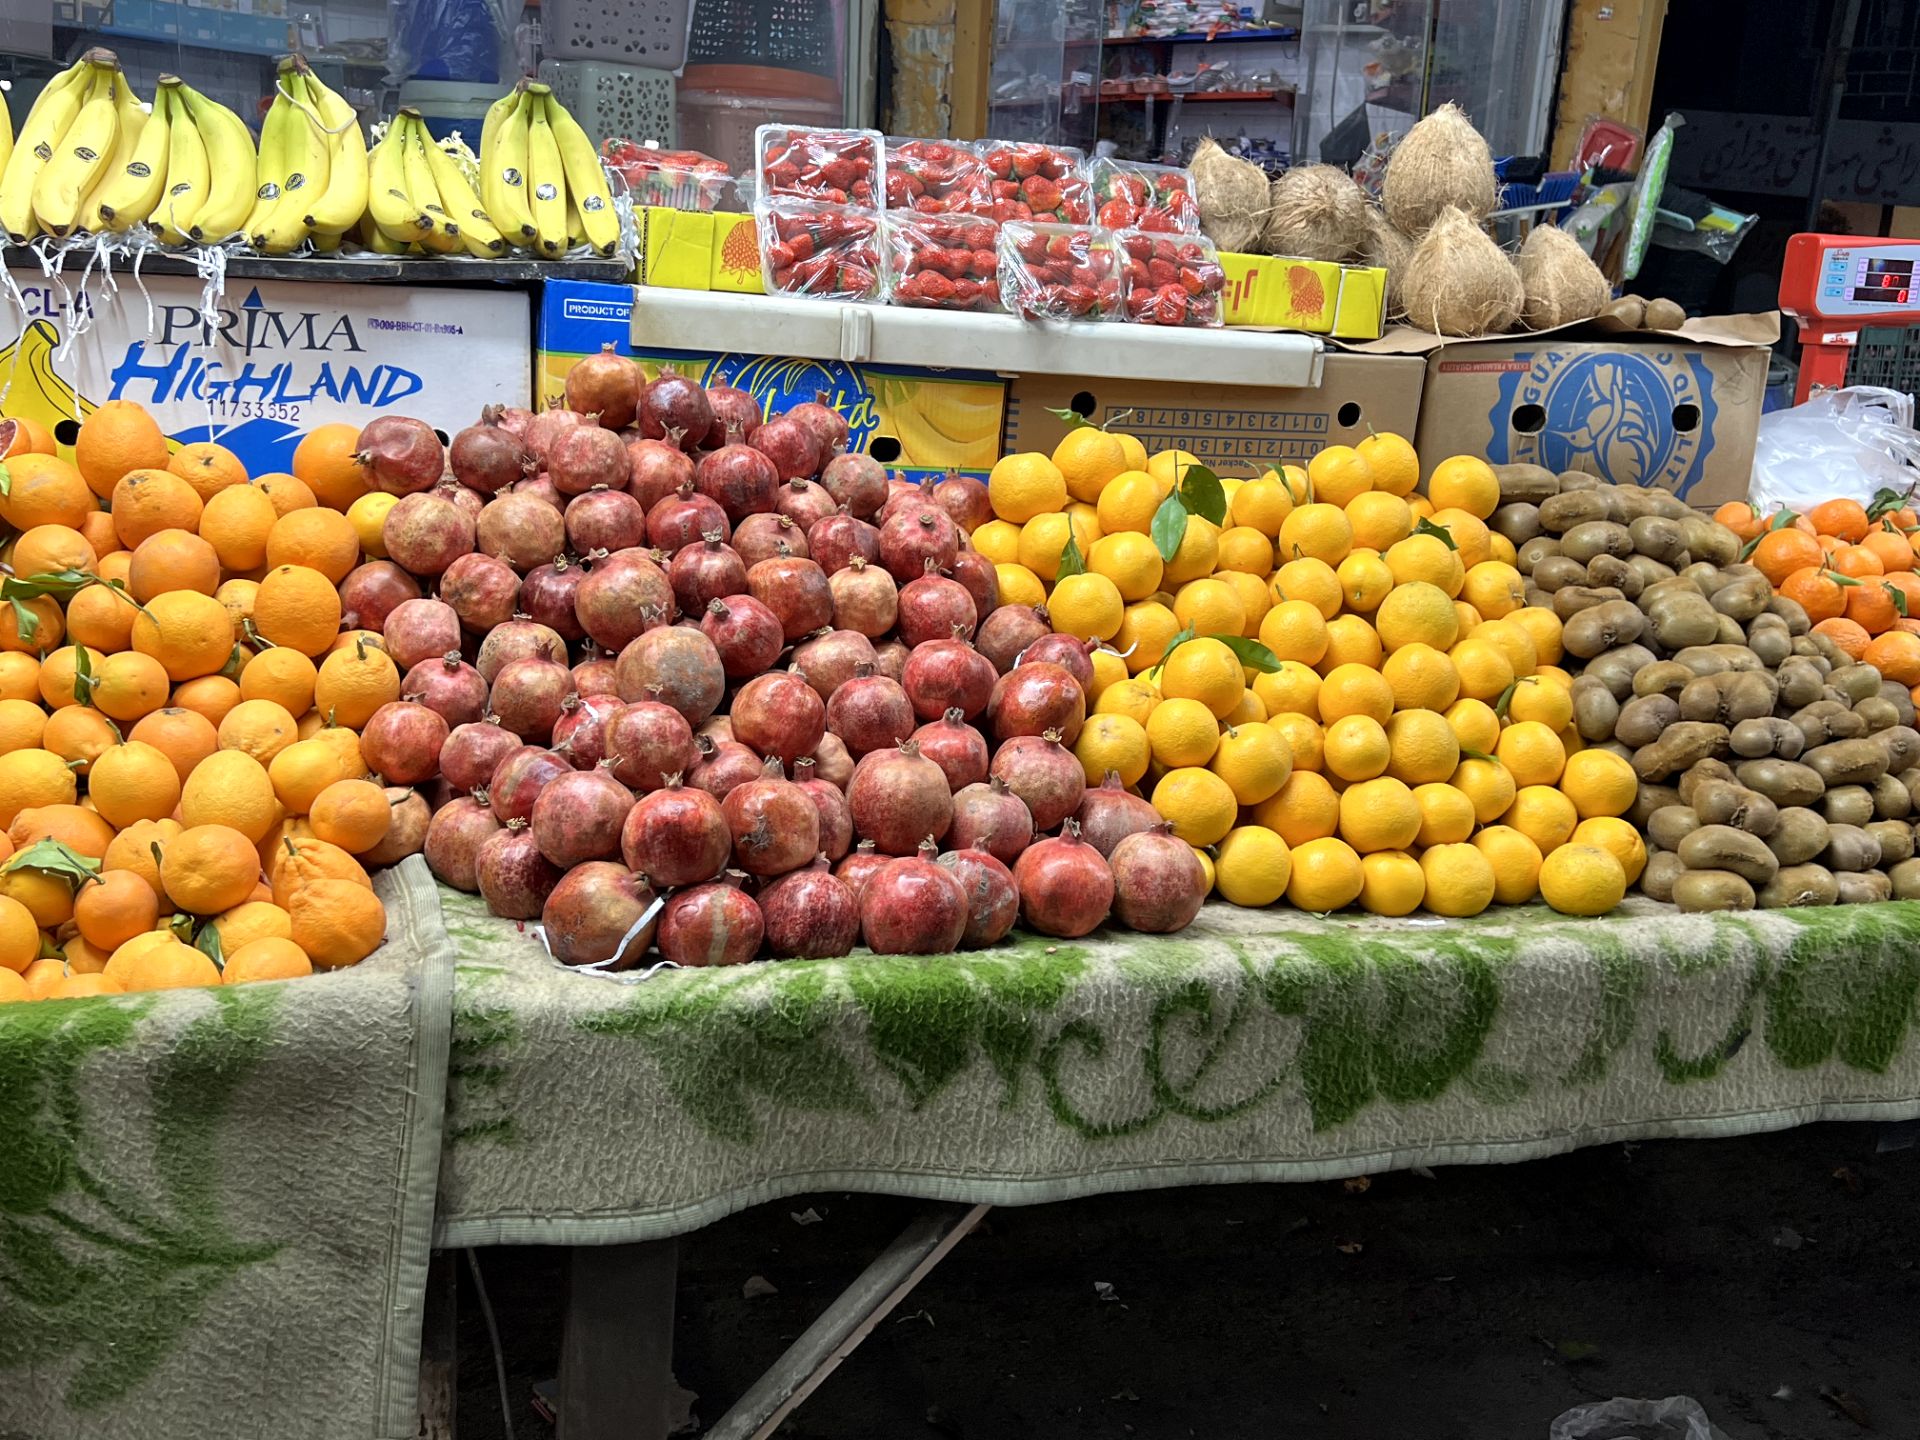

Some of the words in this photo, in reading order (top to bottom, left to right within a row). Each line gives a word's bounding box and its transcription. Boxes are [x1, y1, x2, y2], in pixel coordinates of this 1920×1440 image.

[20, 288, 94, 319] CL-A
[155, 285, 367, 357] PRIMA
[569, 304, 614, 316] PRODUCT
[616, 308, 630, 316] OF
[106, 339, 423, 408] HIGHLAND
